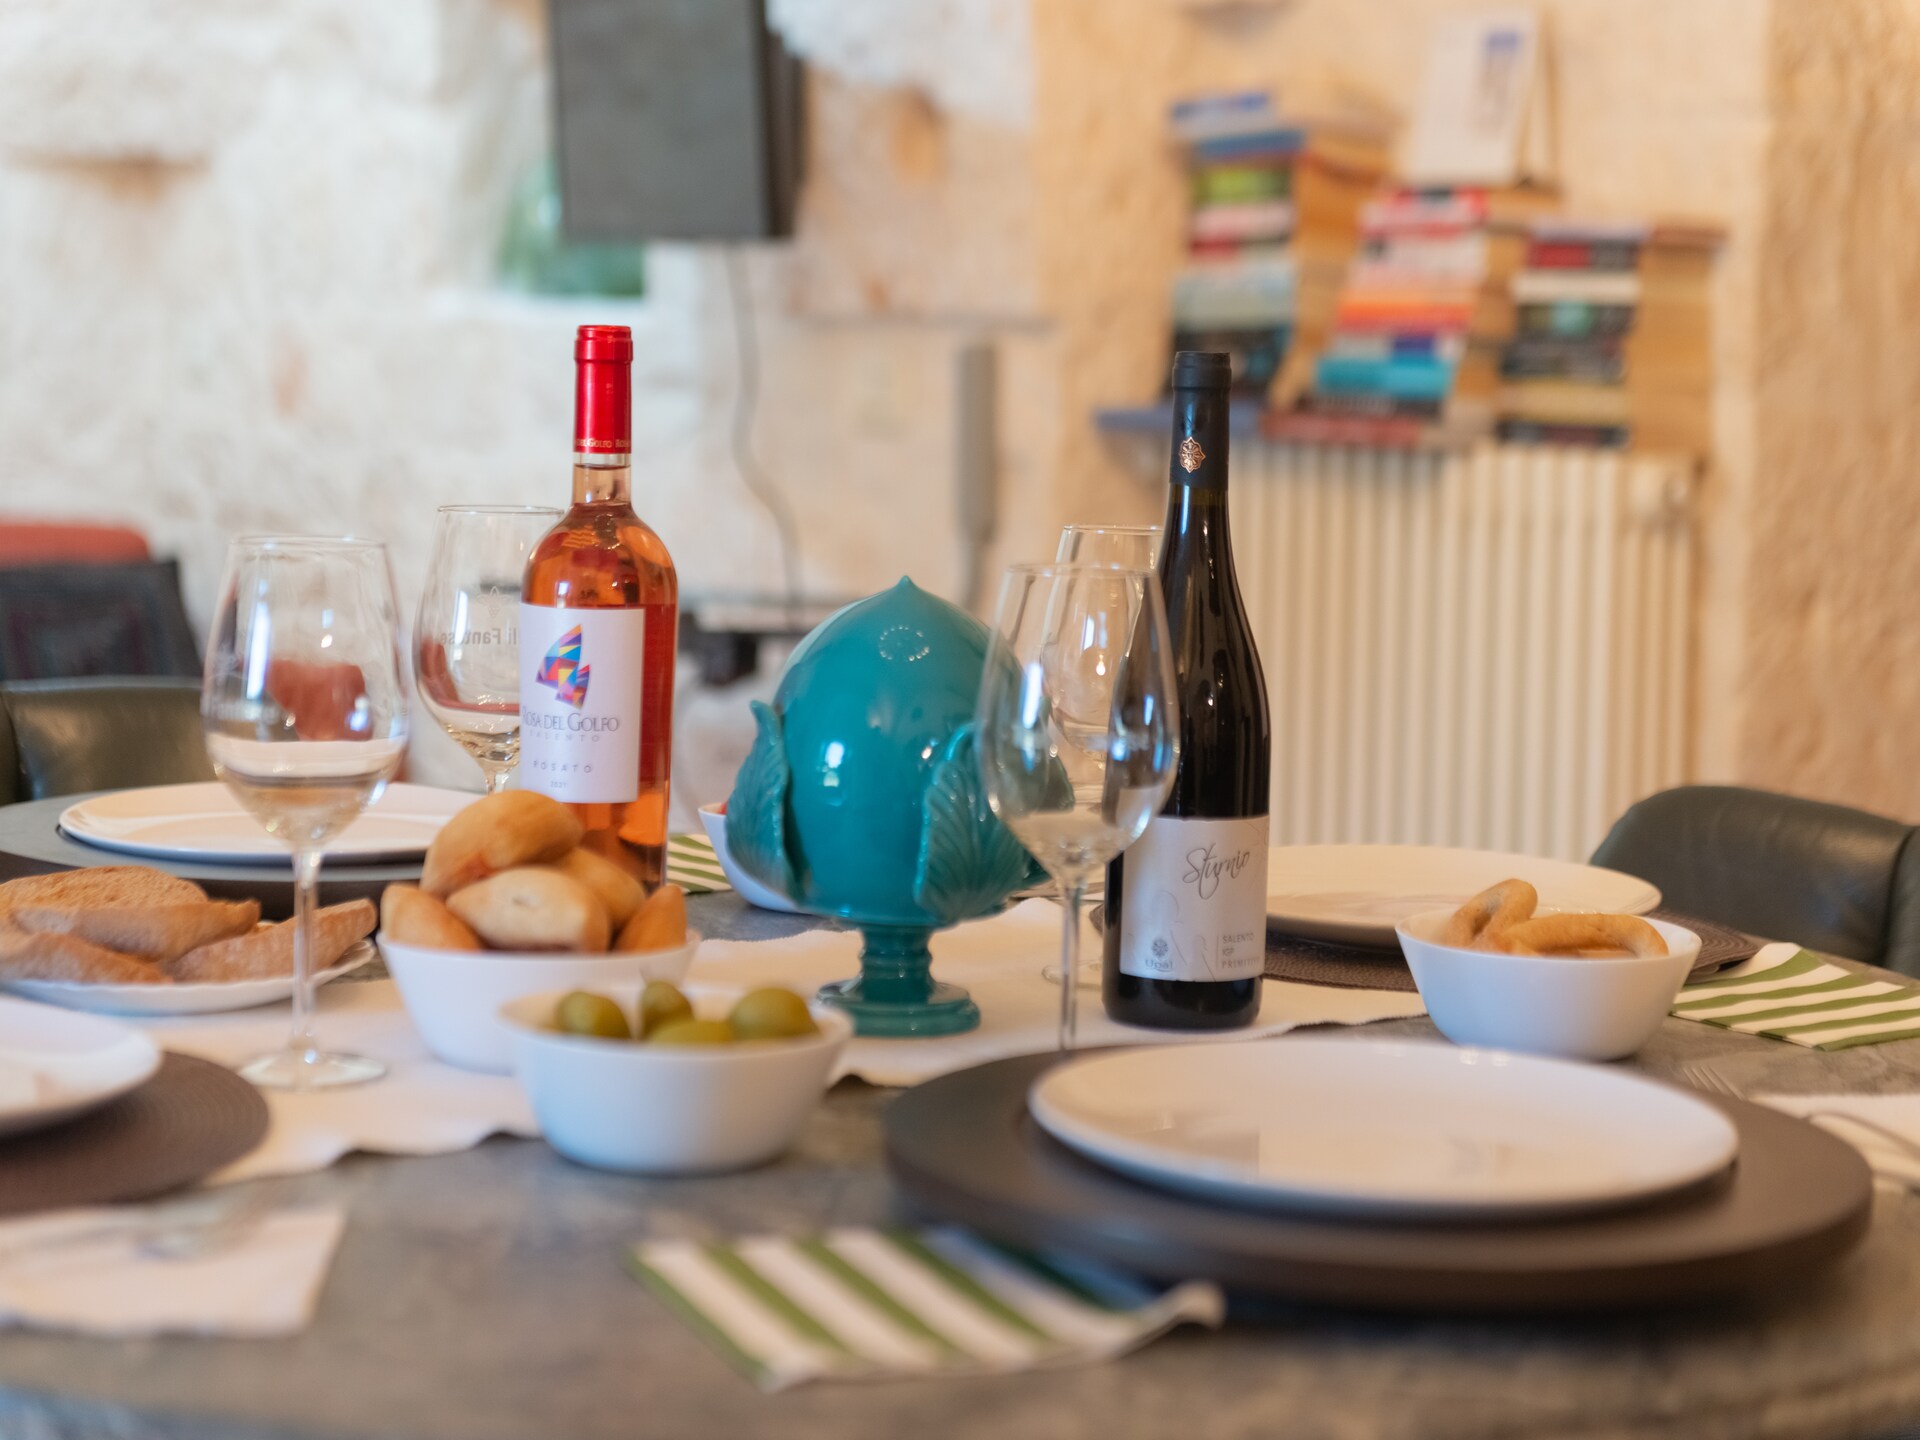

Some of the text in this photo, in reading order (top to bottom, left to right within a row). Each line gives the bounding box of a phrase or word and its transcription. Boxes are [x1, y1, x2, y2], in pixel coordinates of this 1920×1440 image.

[522, 706, 619, 731] ROSA DEL GOLFO
[530, 730, 600, 742] SALENTO
[533, 760, 592, 773] ROSATO
[1222, 932, 1255, 944] SALENTO
